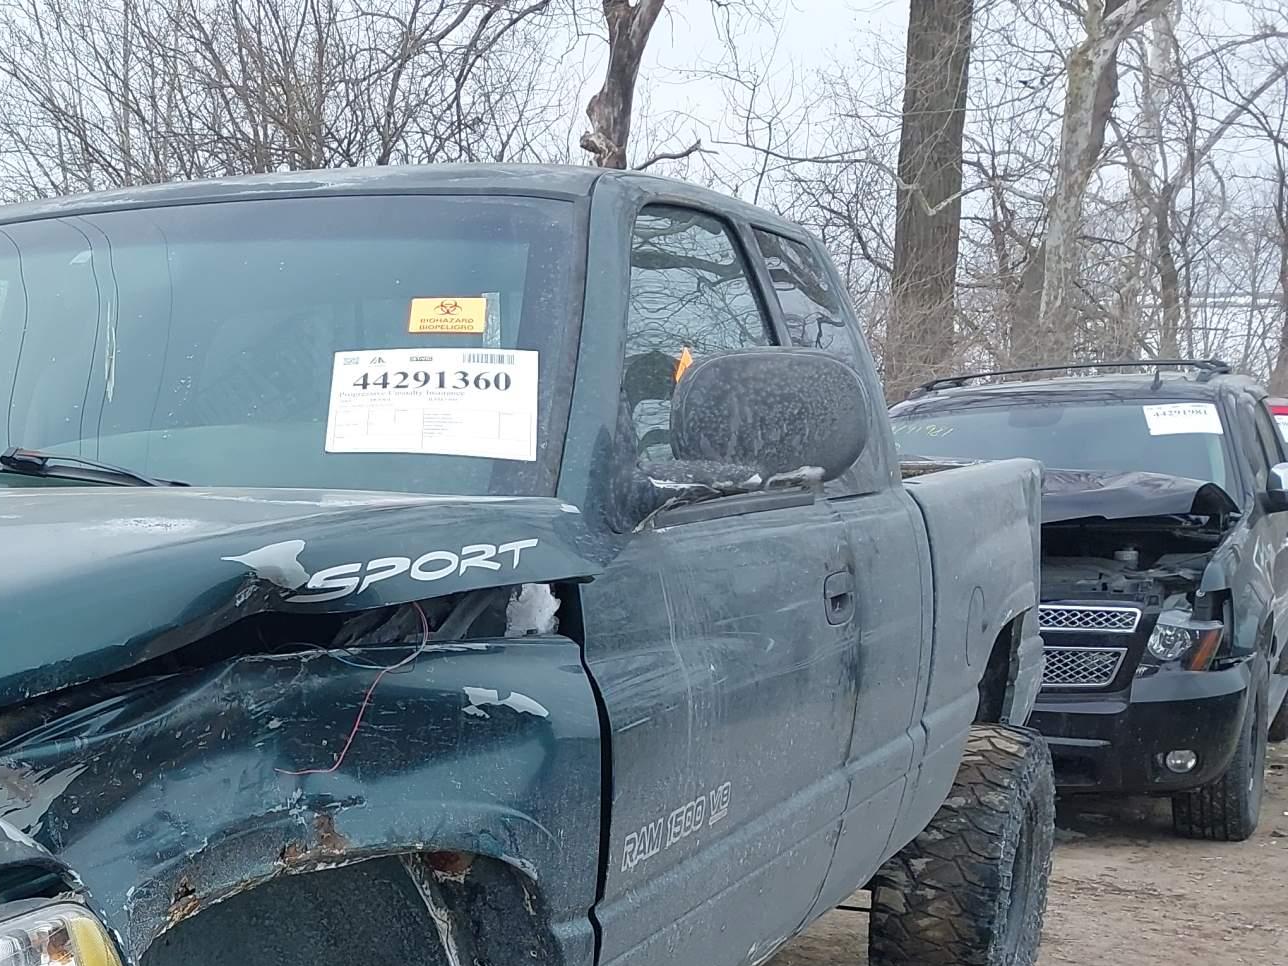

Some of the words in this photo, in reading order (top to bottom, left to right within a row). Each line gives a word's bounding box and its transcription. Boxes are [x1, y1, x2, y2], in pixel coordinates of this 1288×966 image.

[352, 370, 512, 391] 44291360
[284, 538, 539, 603] SPORT
[620, 817, 664, 872] RAM
[664, 796, 706, 850] 1500
[709, 781, 732, 815] V8
